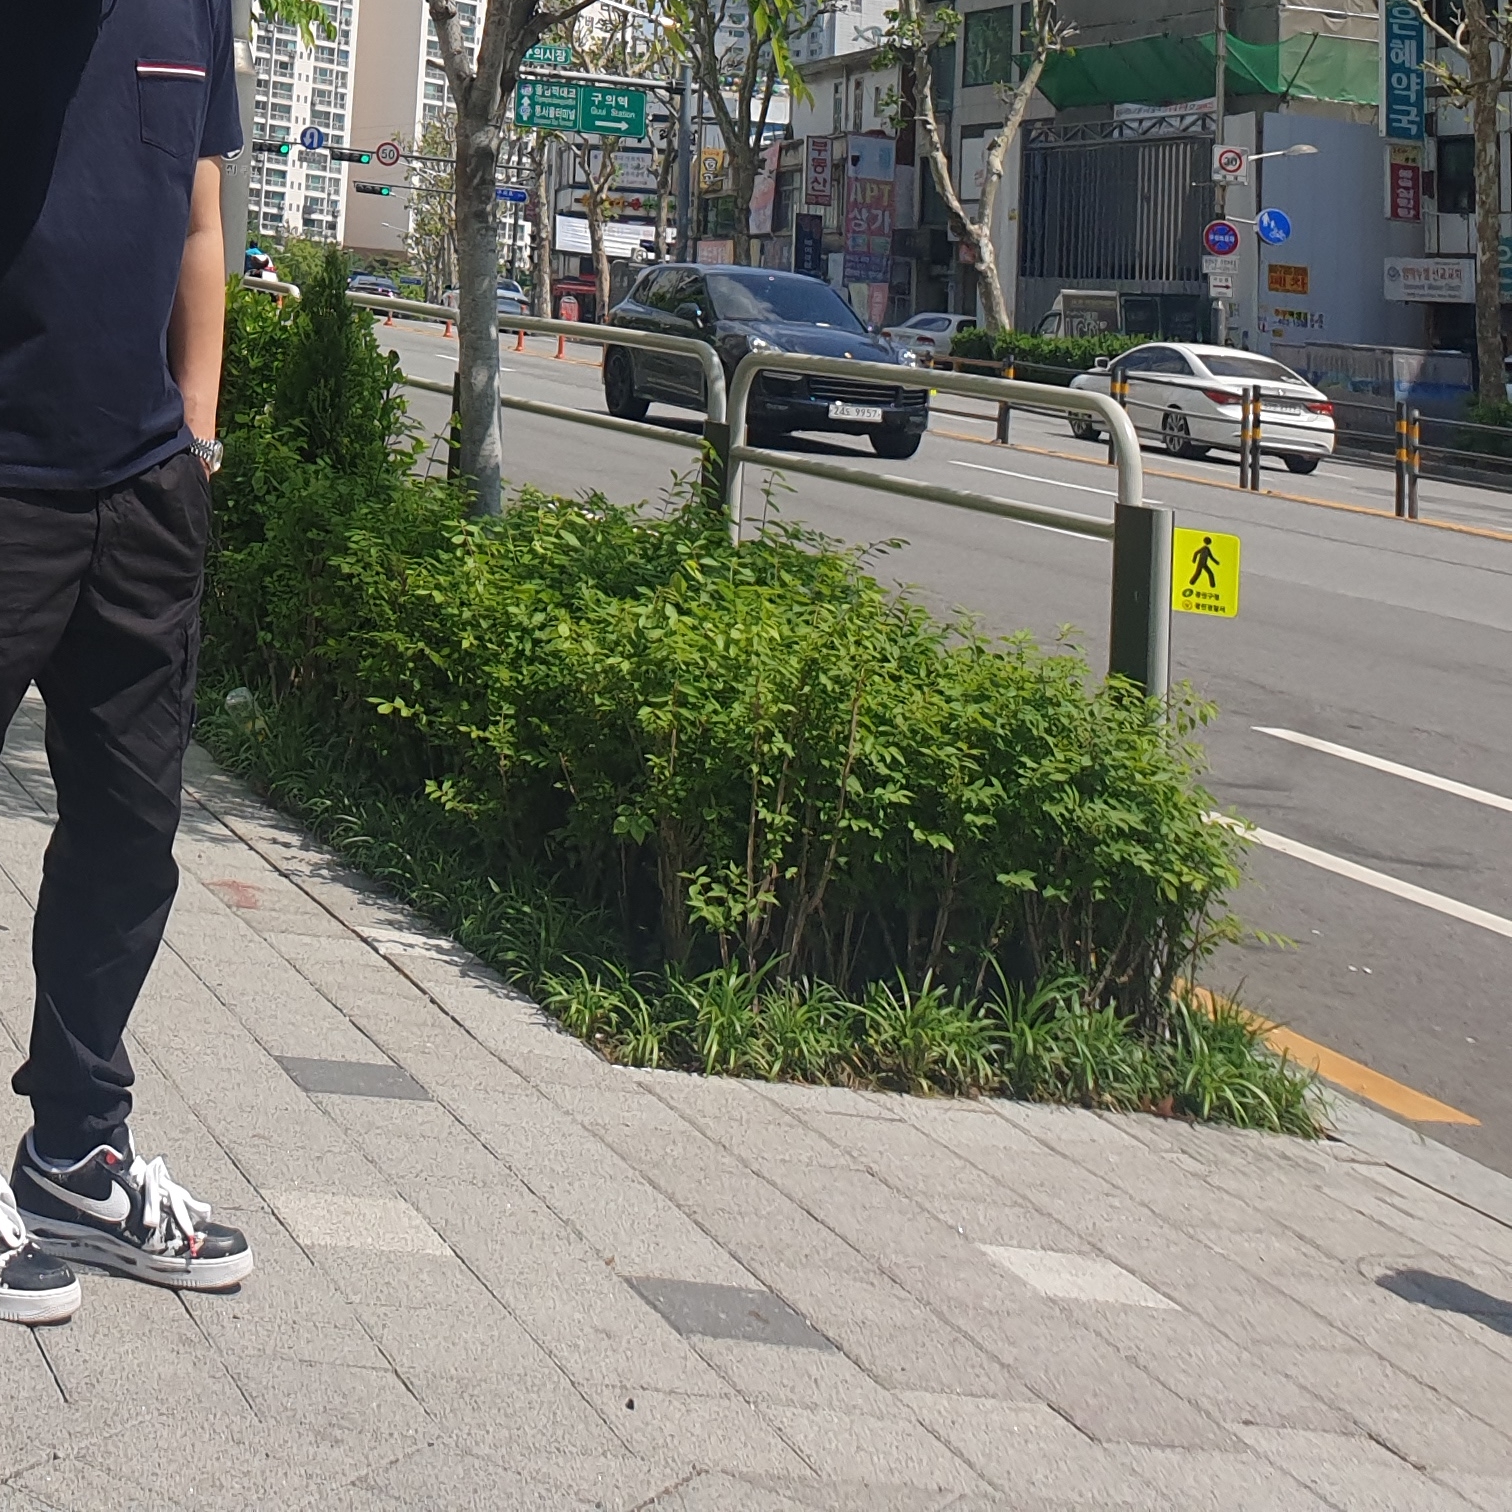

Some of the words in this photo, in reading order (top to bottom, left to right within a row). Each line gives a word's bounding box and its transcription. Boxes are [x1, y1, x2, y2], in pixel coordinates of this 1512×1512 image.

[590, 92, 629, 109] 구의역
[610, 108, 636, 119] Station
[380, 148, 395, 161] 50
[1223, 156, 1238, 167] 30
[810, 139, 828, 193] 부동산
[849, 180, 892, 206] APT
[848, 207, 892, 235] 상가
[855, 407, 878, 419] 9957
